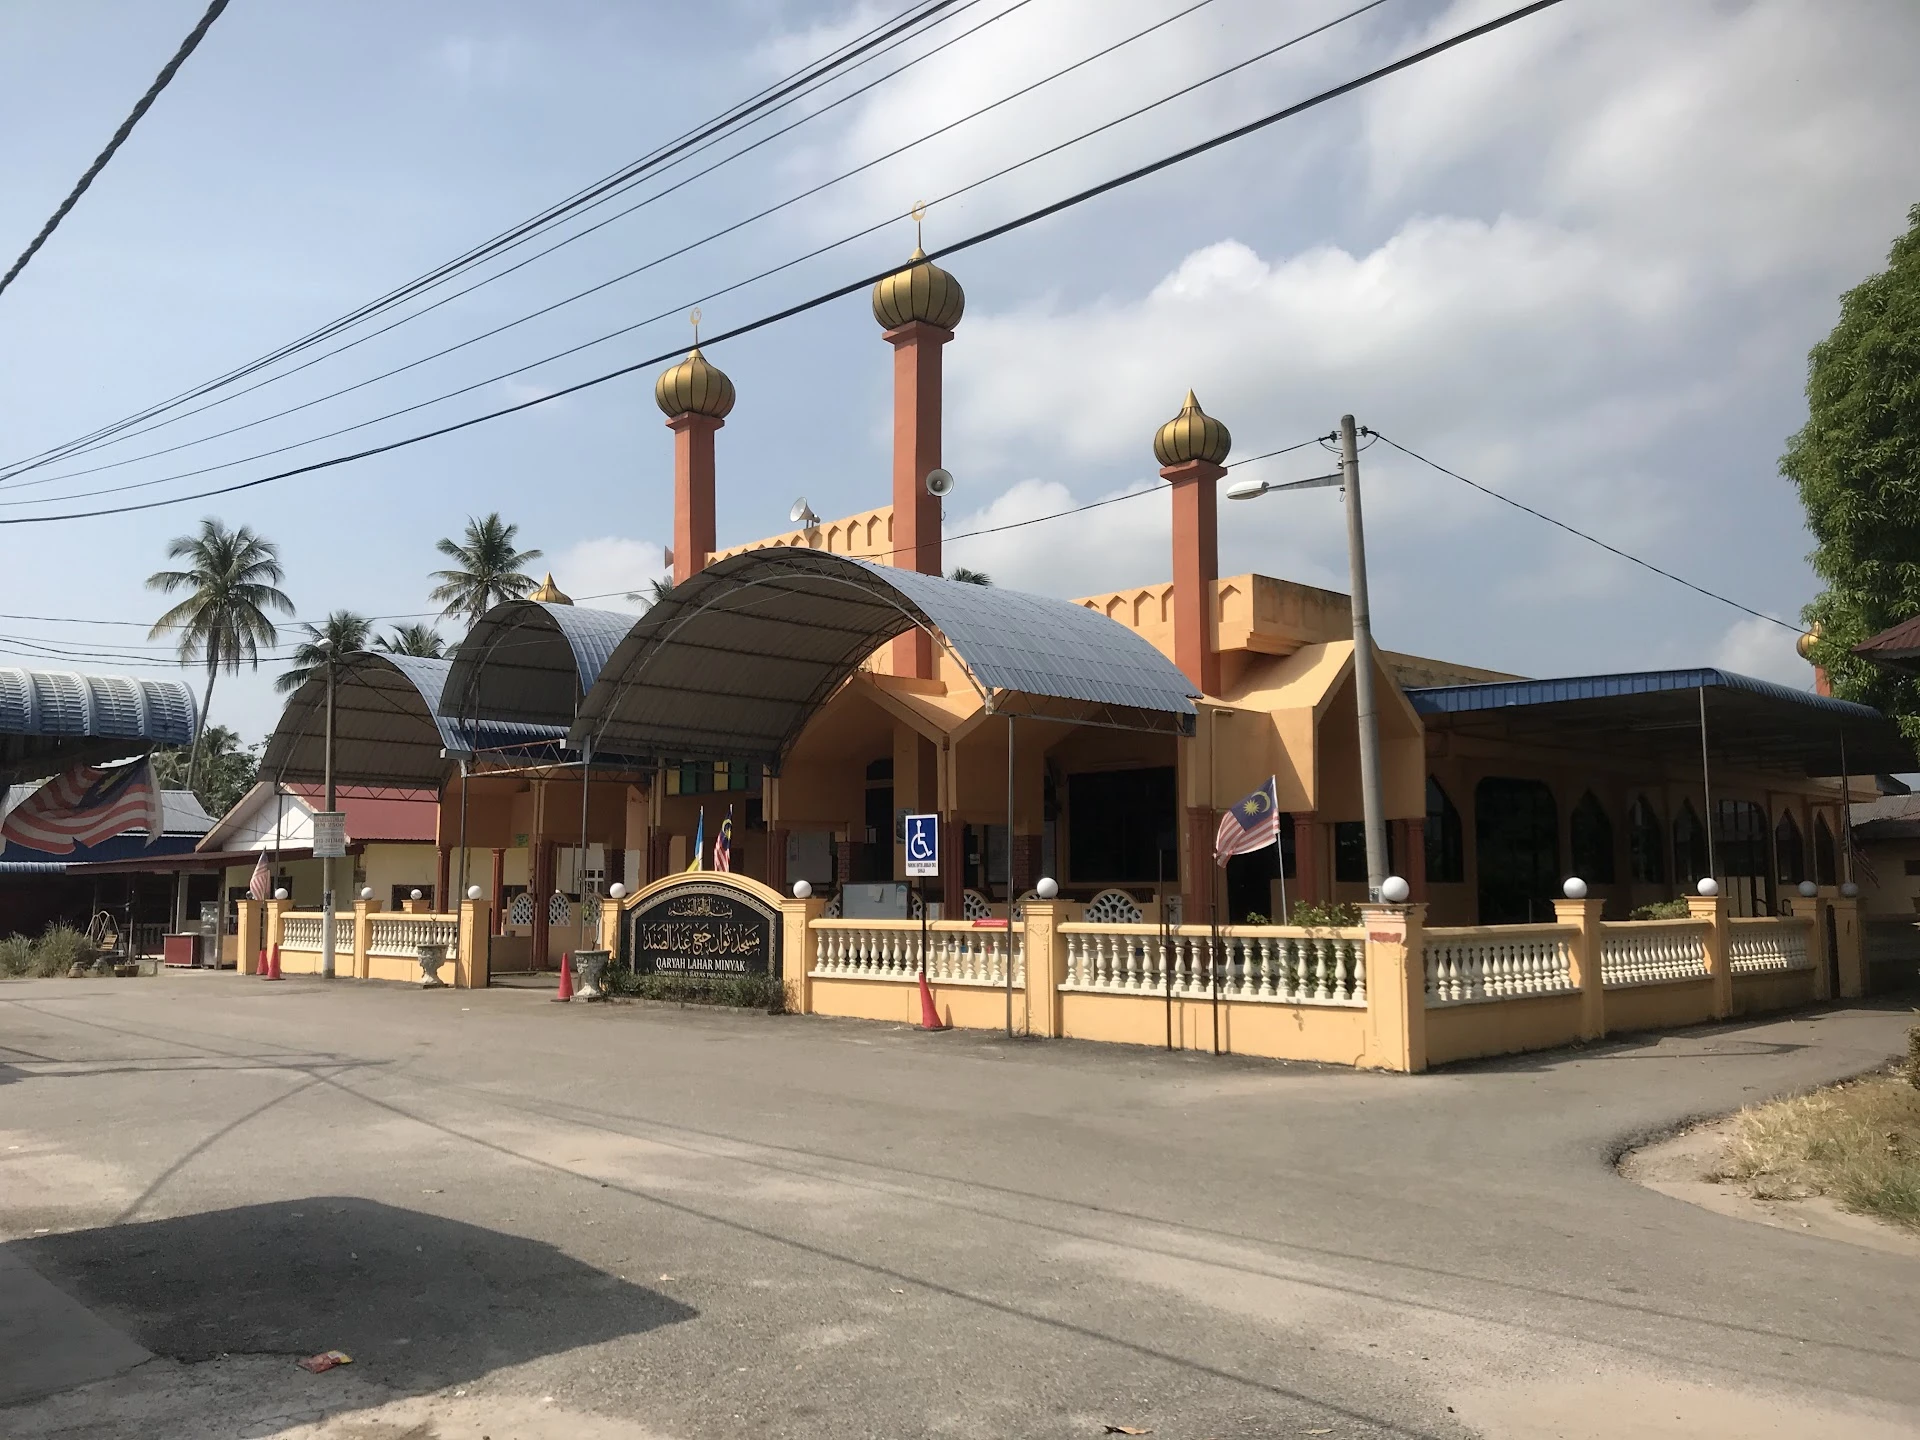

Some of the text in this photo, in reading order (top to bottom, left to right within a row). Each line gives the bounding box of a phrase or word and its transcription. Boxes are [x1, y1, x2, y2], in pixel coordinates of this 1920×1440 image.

[656, 957, 746, 972] QARYAH LAHAR MINYAK
